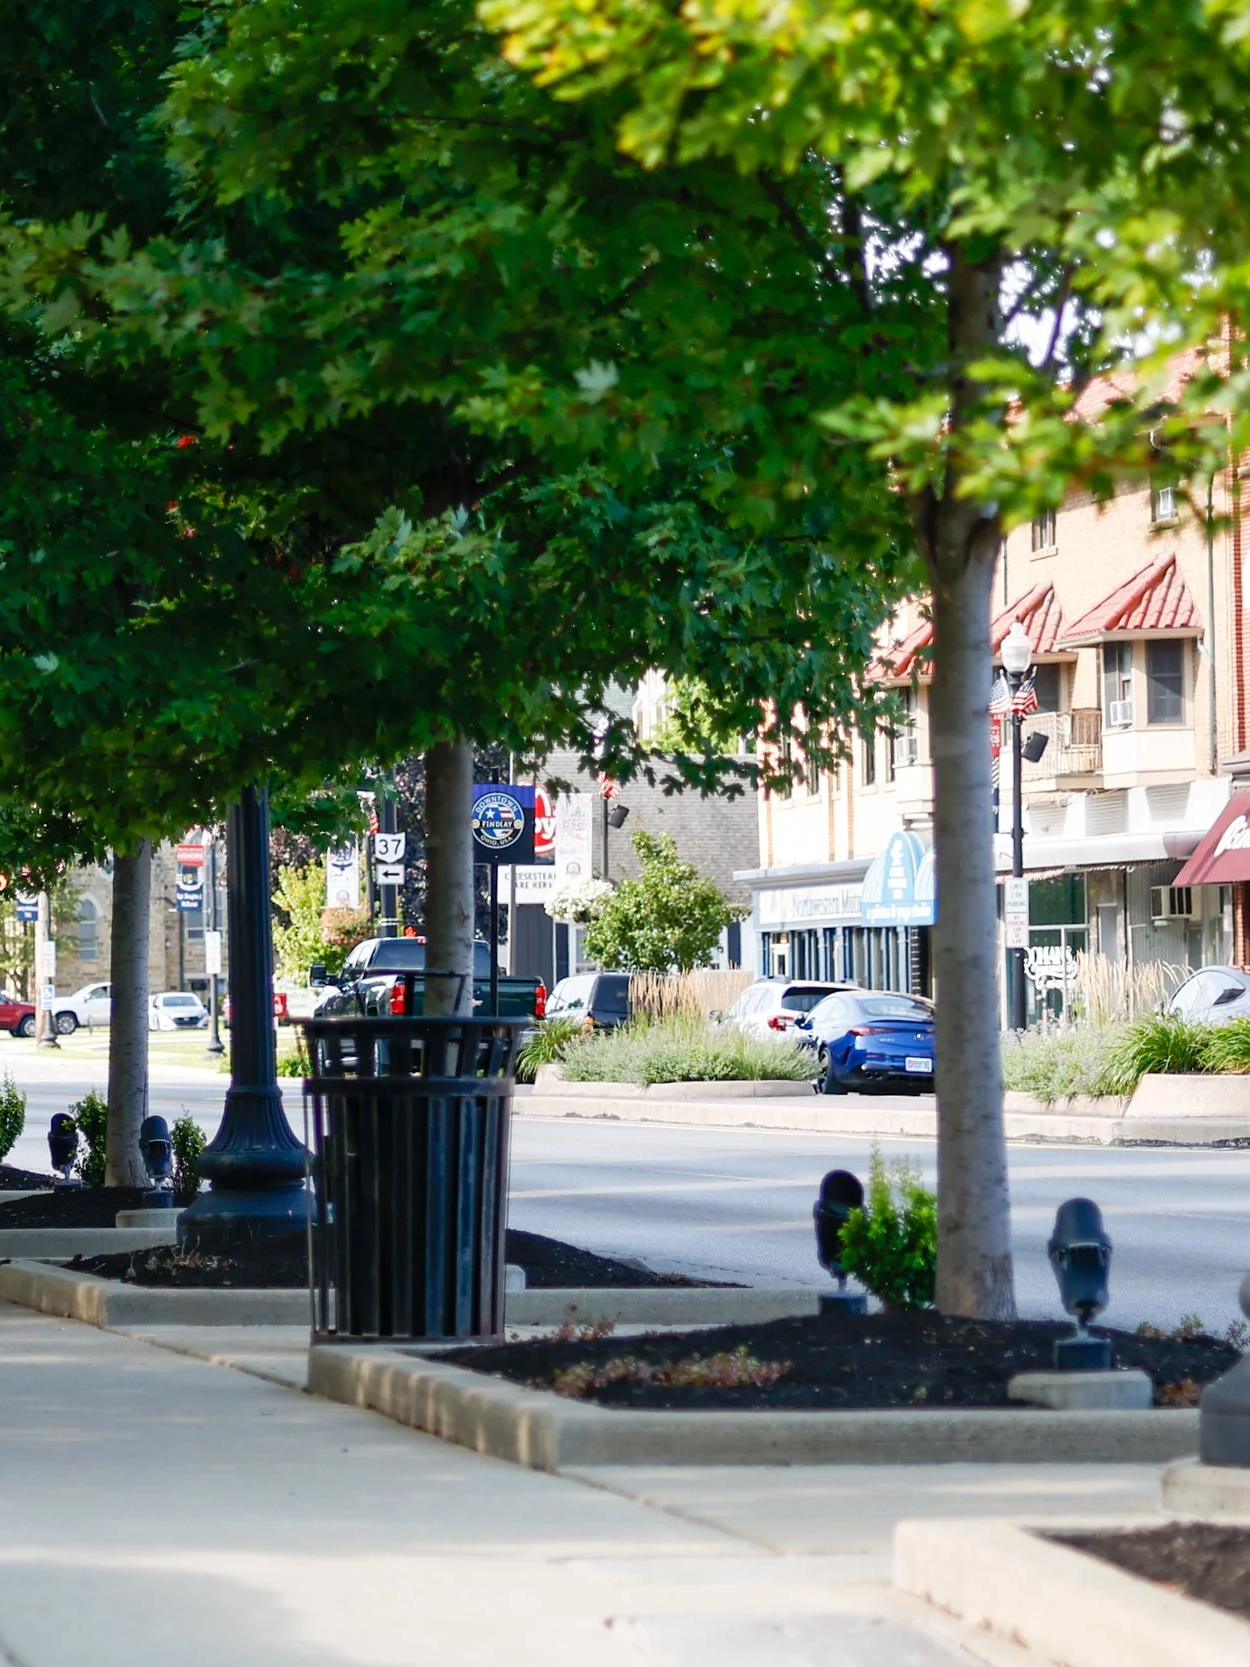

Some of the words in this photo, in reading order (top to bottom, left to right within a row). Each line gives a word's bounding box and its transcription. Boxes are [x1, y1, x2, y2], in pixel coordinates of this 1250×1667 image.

[475, 795, 519, 814] DOWNTOWN
[378, 839, 401, 855] 37
[500, 837, 514, 846] USA
